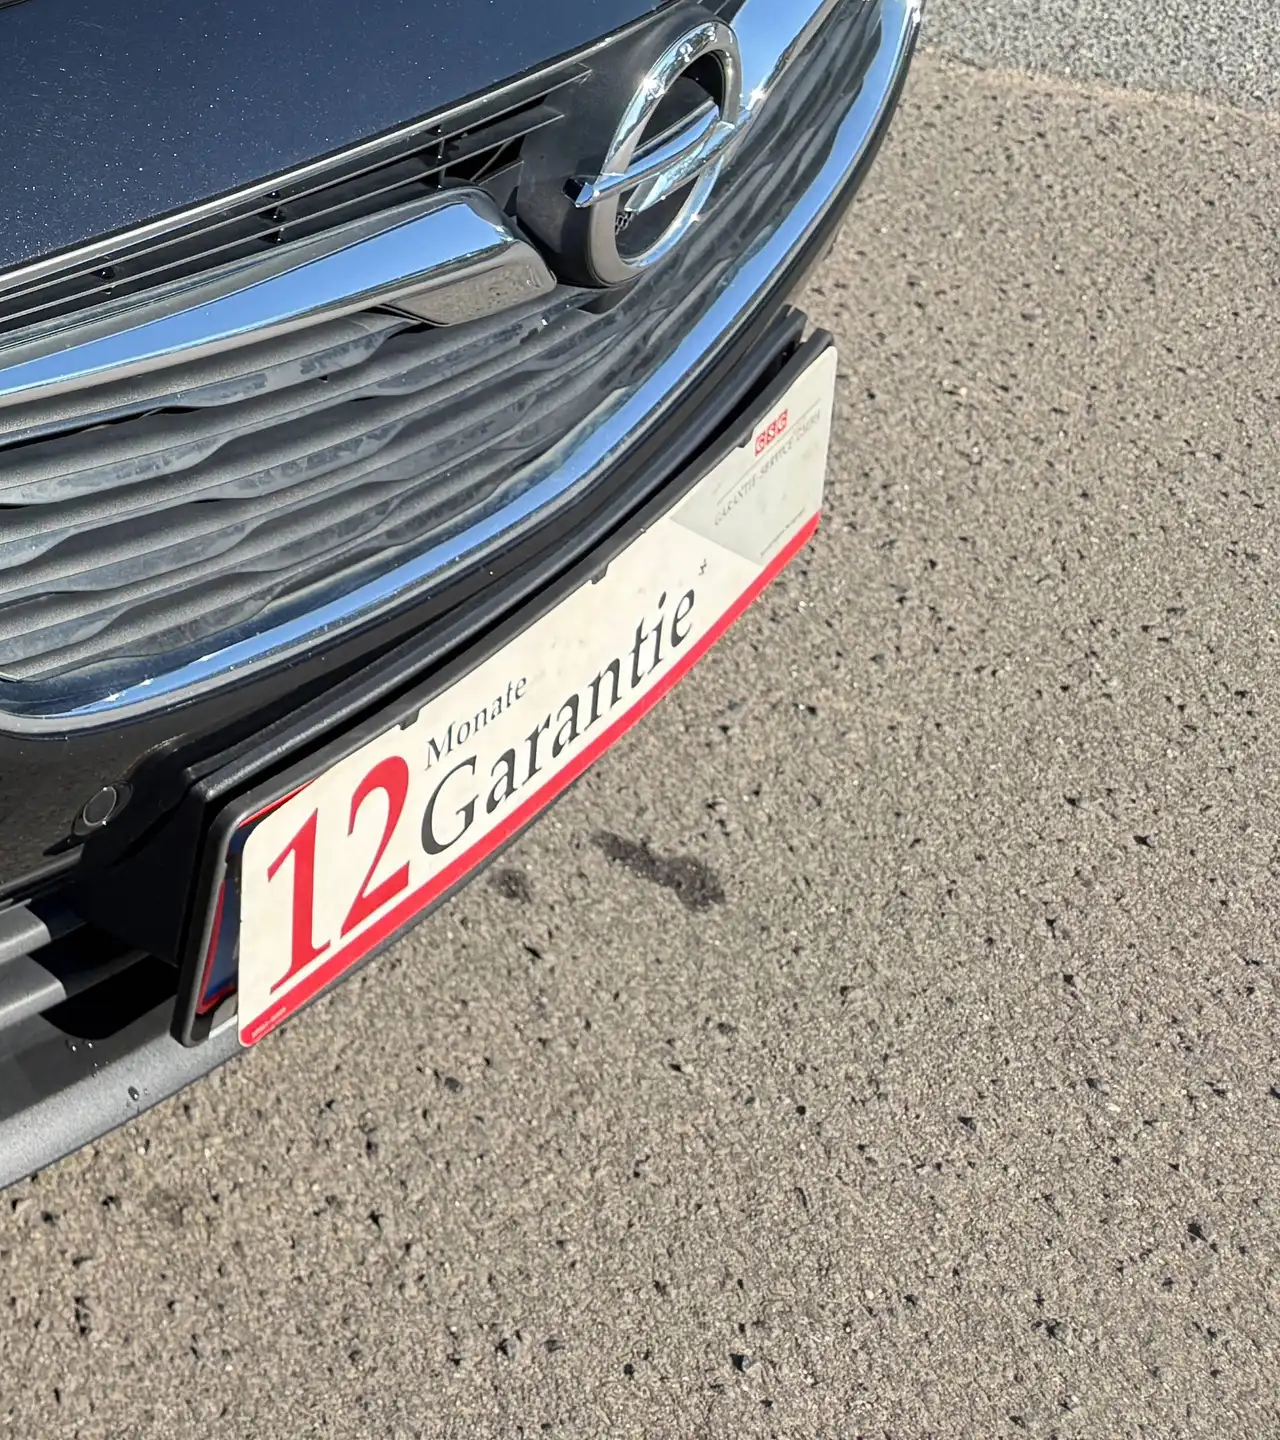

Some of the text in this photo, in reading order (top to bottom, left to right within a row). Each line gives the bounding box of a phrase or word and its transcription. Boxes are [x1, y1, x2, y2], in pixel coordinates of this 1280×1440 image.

[267, 588, 696, 996] 12 Garantie
[424, 674, 528, 771] Monate
